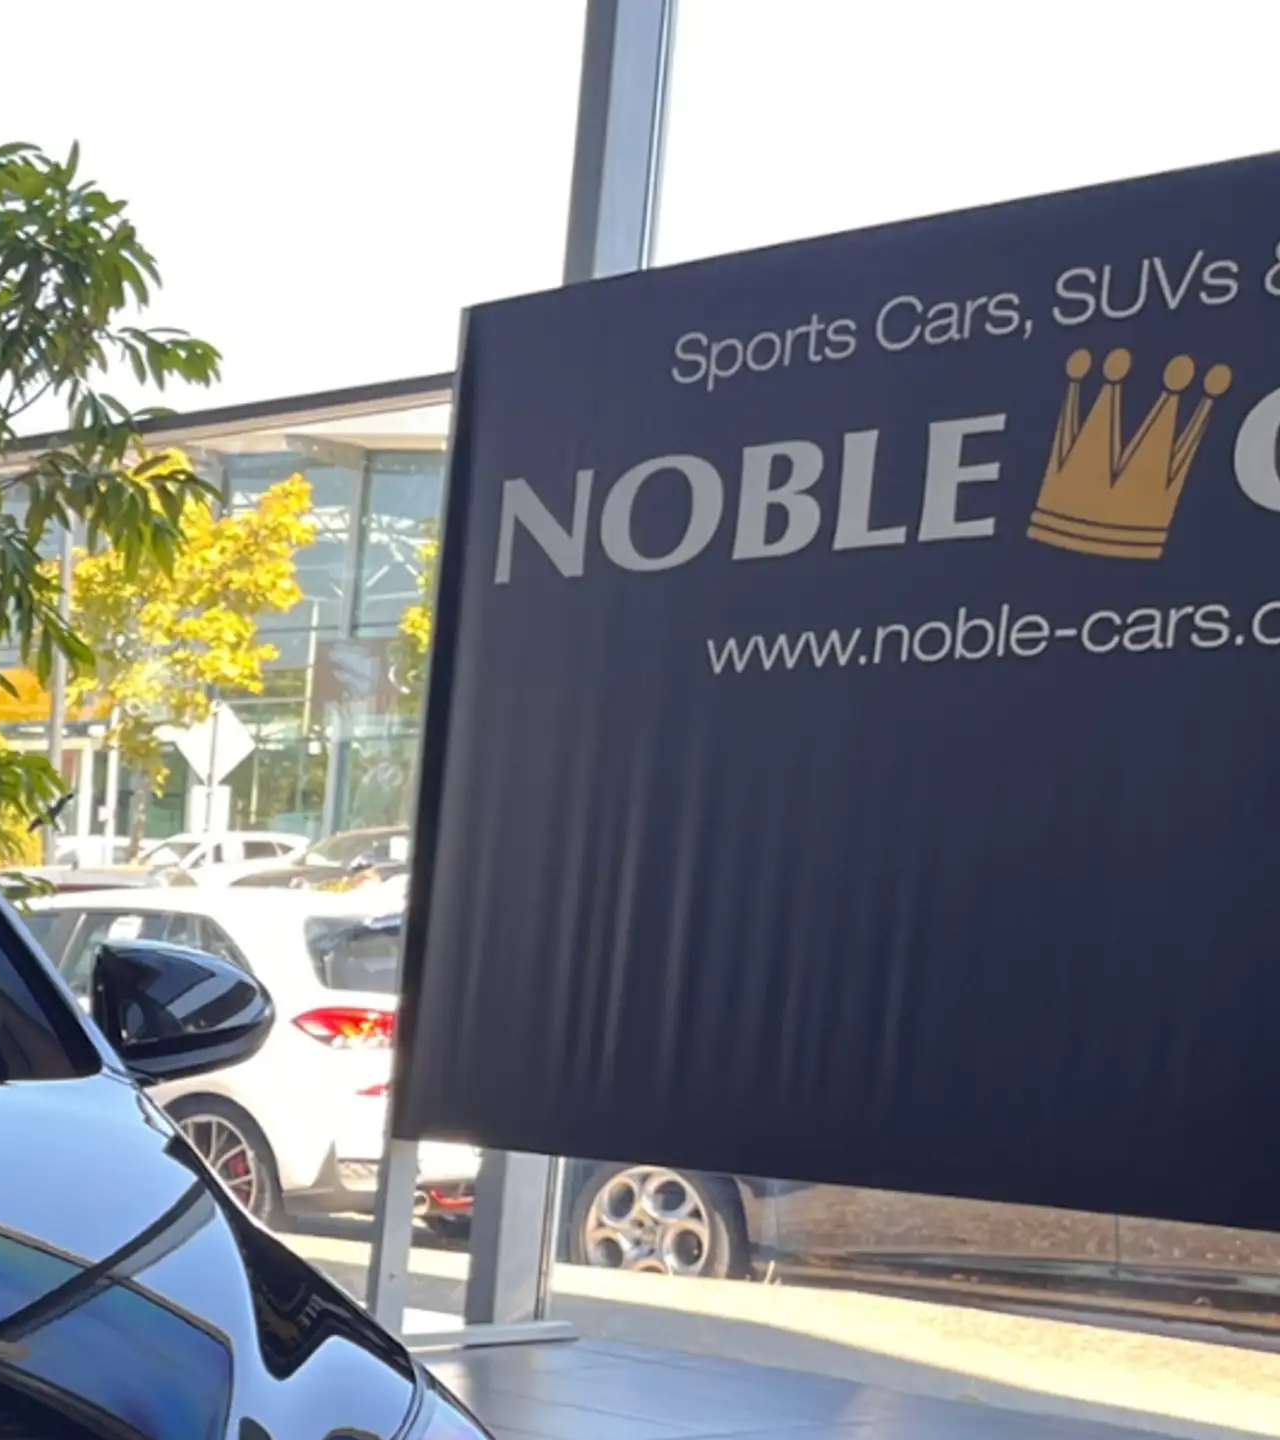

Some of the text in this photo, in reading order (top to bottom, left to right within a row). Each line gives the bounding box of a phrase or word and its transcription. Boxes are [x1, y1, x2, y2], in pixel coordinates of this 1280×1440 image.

[672, 313, 857, 391] Sports
[876, 292, 1032, 351] Cars,
[1052, 250, 1238, 325] SUVs
[493, 412, 1007, 584] NOBLE
